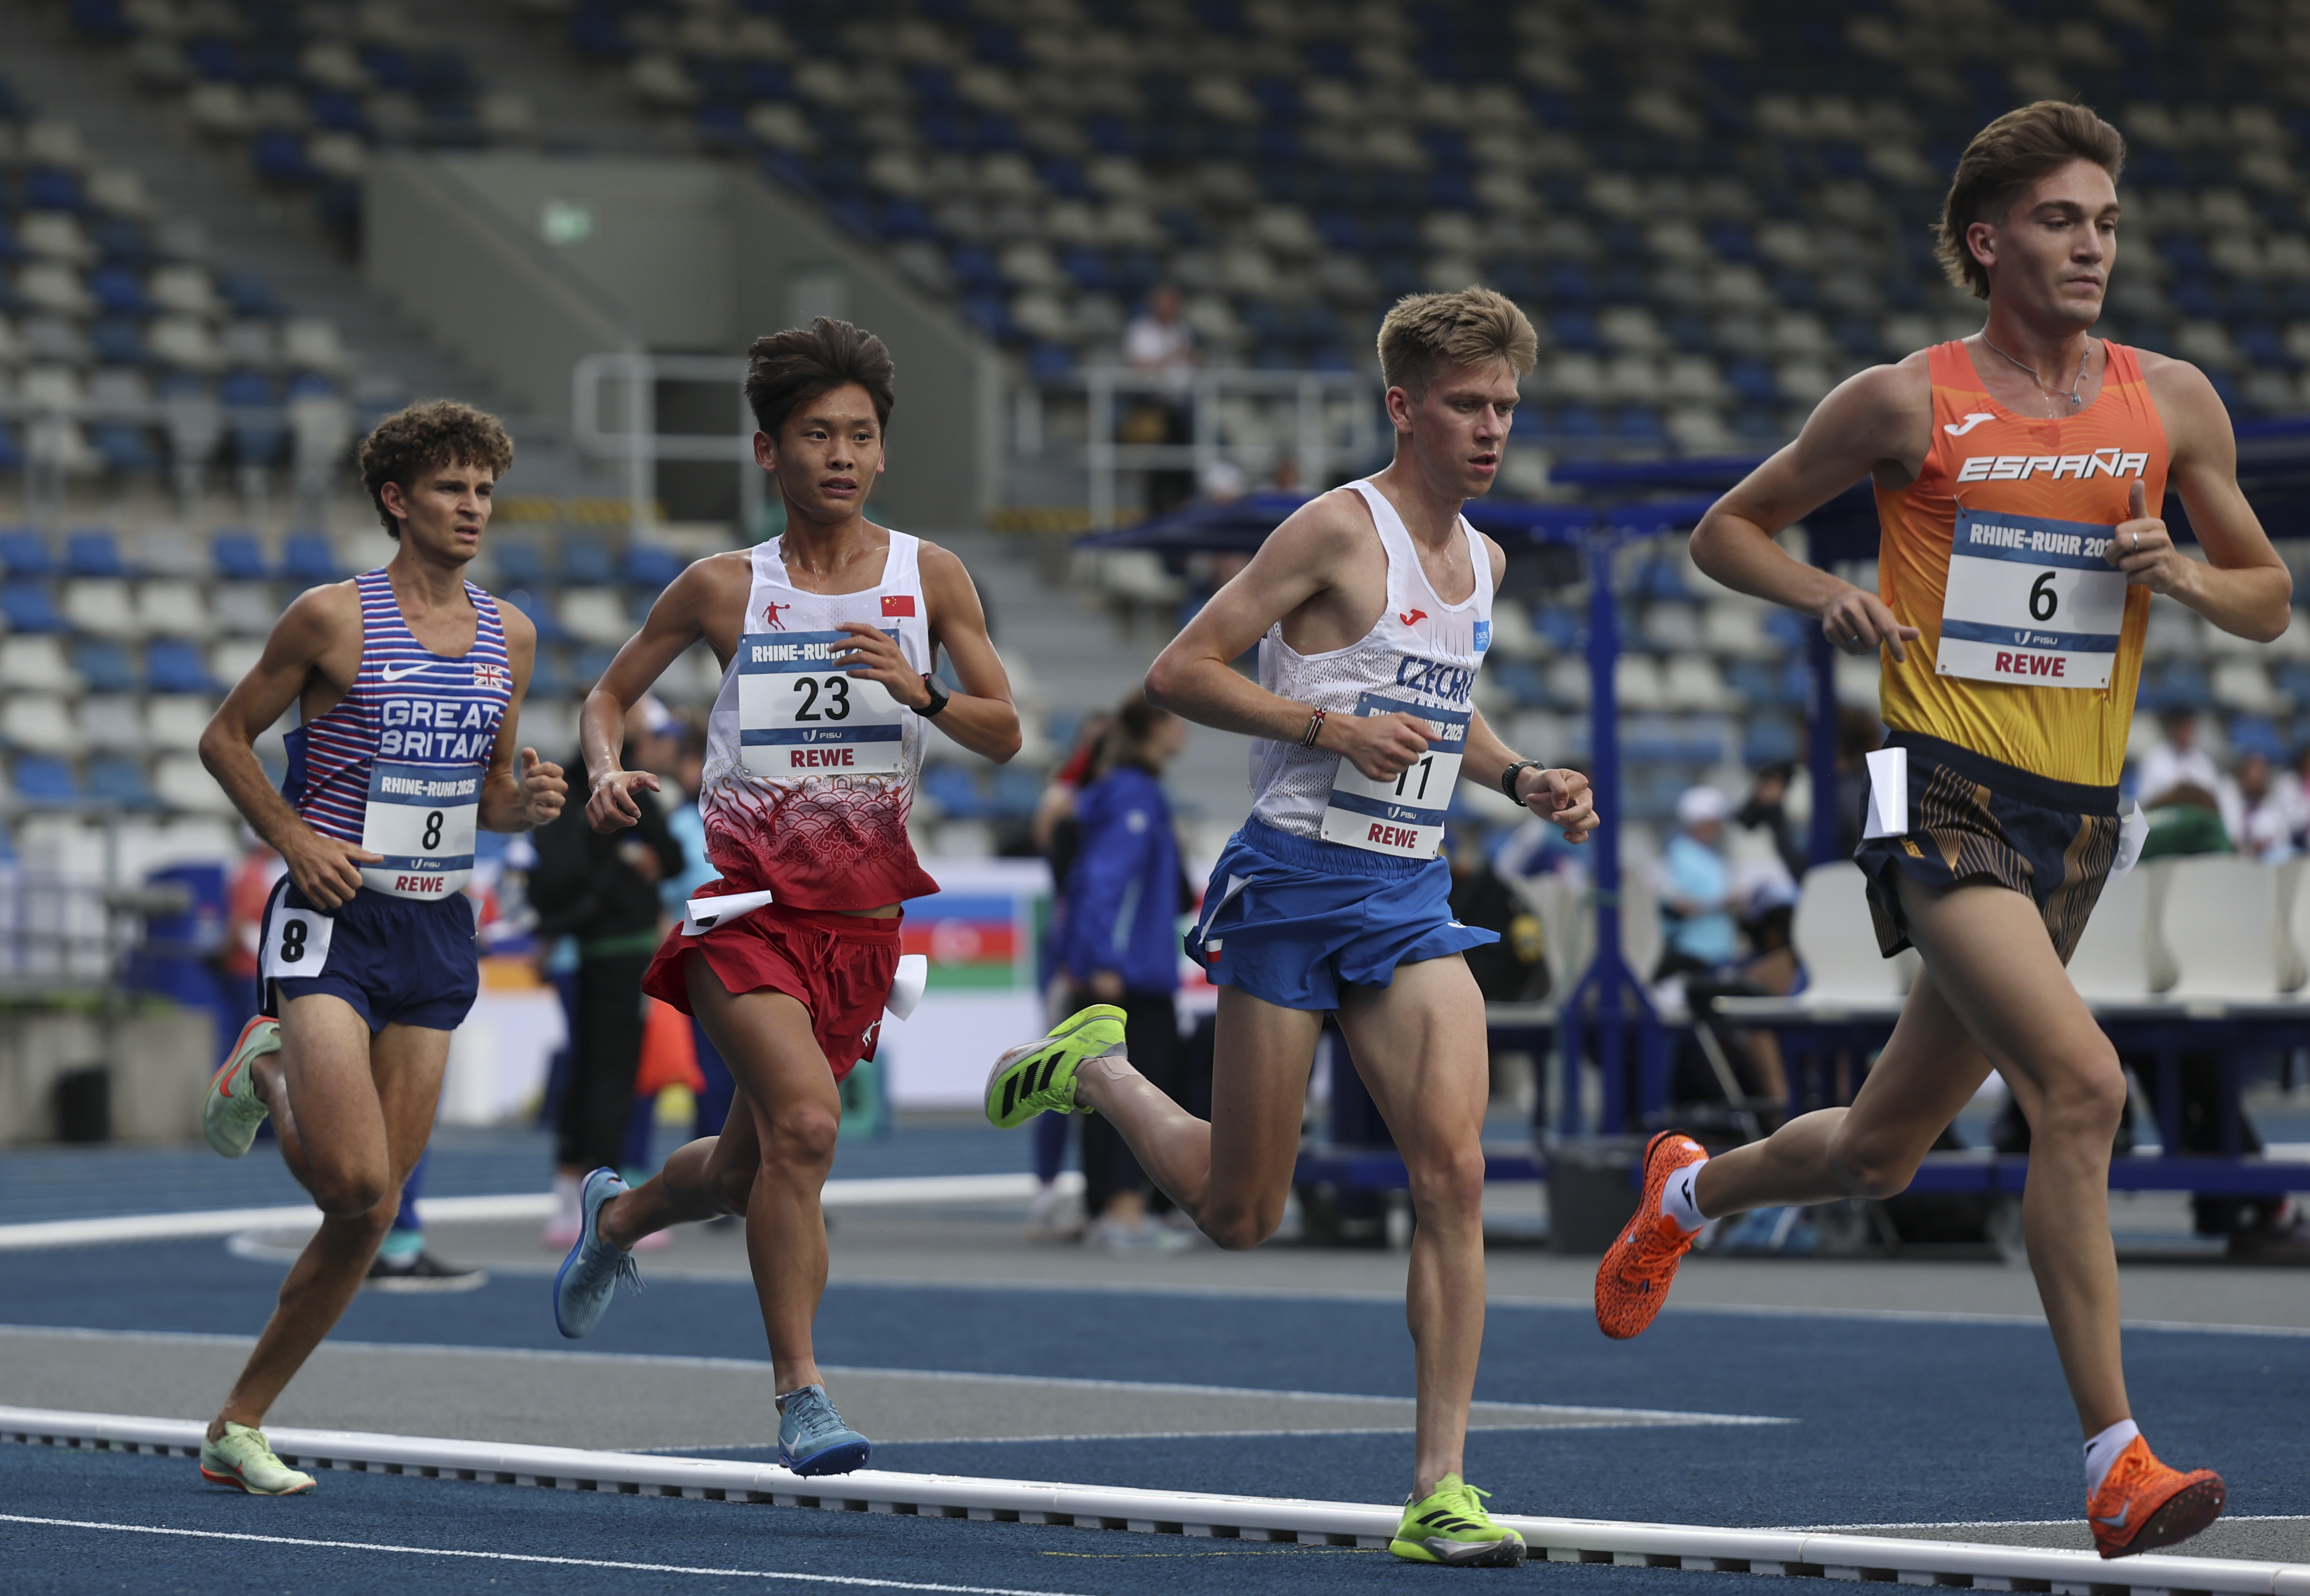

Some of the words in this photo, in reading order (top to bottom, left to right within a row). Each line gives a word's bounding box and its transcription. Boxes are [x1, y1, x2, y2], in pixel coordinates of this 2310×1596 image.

[1957, 448, 2149, 482] ESPAÑA
[1970, 523, 2082, 556] RHINE-RUHR
[2083, 537, 2114, 558] 20
[2029, 571, 2058, 621] 6
[2033, 636, 2058, 645] FISU
[1995, 651, 2066, 677] REWE
[793, 675, 850, 721] 23
[383, 700, 499, 729] GREAT
[1443, 723, 1465, 741] 2025
[791, 748, 854, 767] REWE
[381, 776, 457, 797] RHINE-RUHR
[456, 778, 476, 796] 2025
[1395, 755, 1433, 800] 11
[1400, 811, 1416, 819] FISU
[422, 810, 444, 850] 8
[1368, 823, 1418, 848] REWE
[395, 875, 444, 892] REWE
[280, 918, 308, 963] 8
